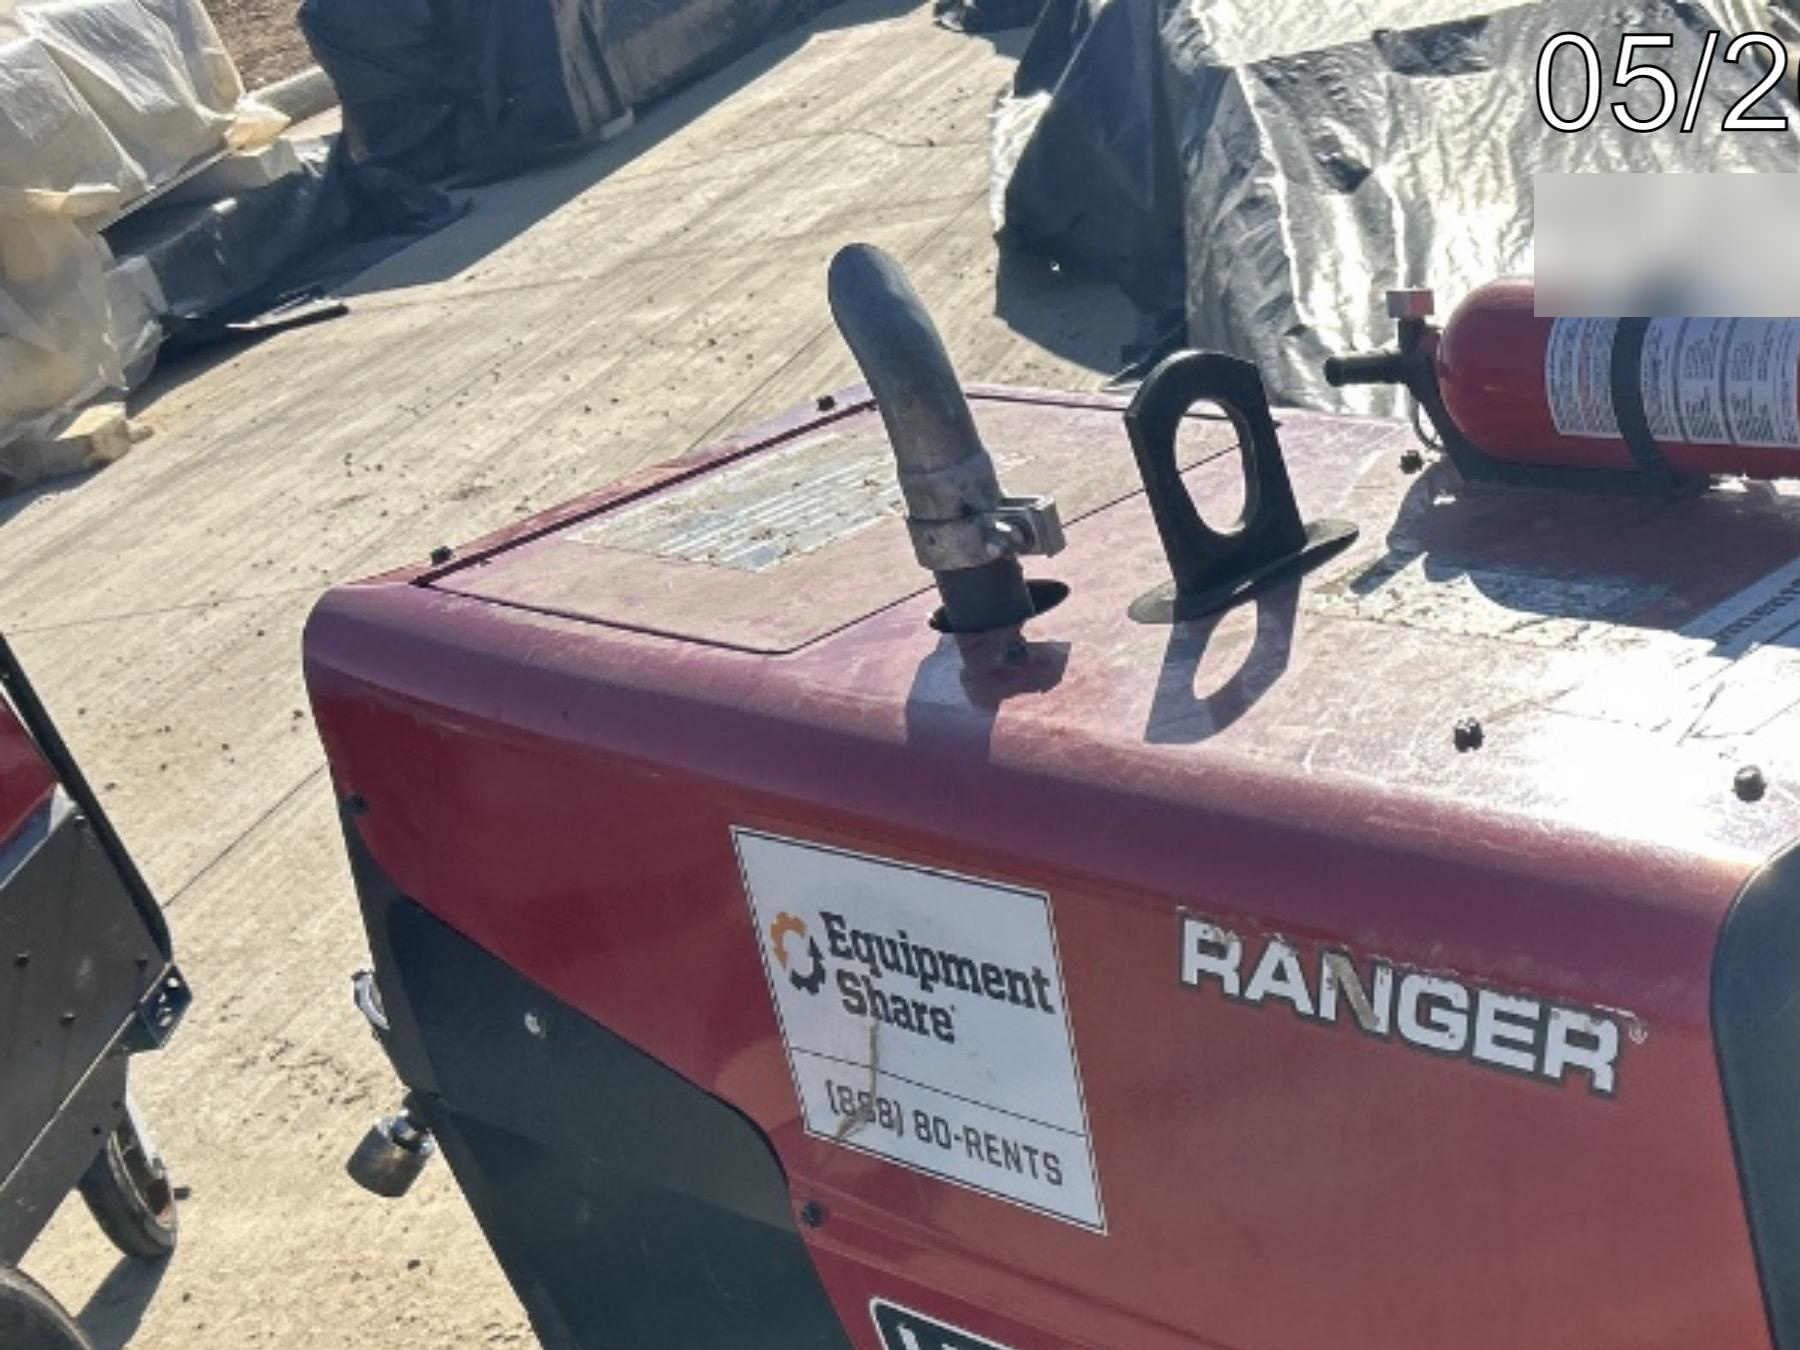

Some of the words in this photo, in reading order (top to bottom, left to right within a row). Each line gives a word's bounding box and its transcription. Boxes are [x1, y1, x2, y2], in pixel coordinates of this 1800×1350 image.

[819, 911, 1056, 1015] Equipment
[836, 968, 956, 1044] Share
[1179, 917, 1620, 1094] RANGER
[913, 1109, 1064, 1187] 80-RENTS
